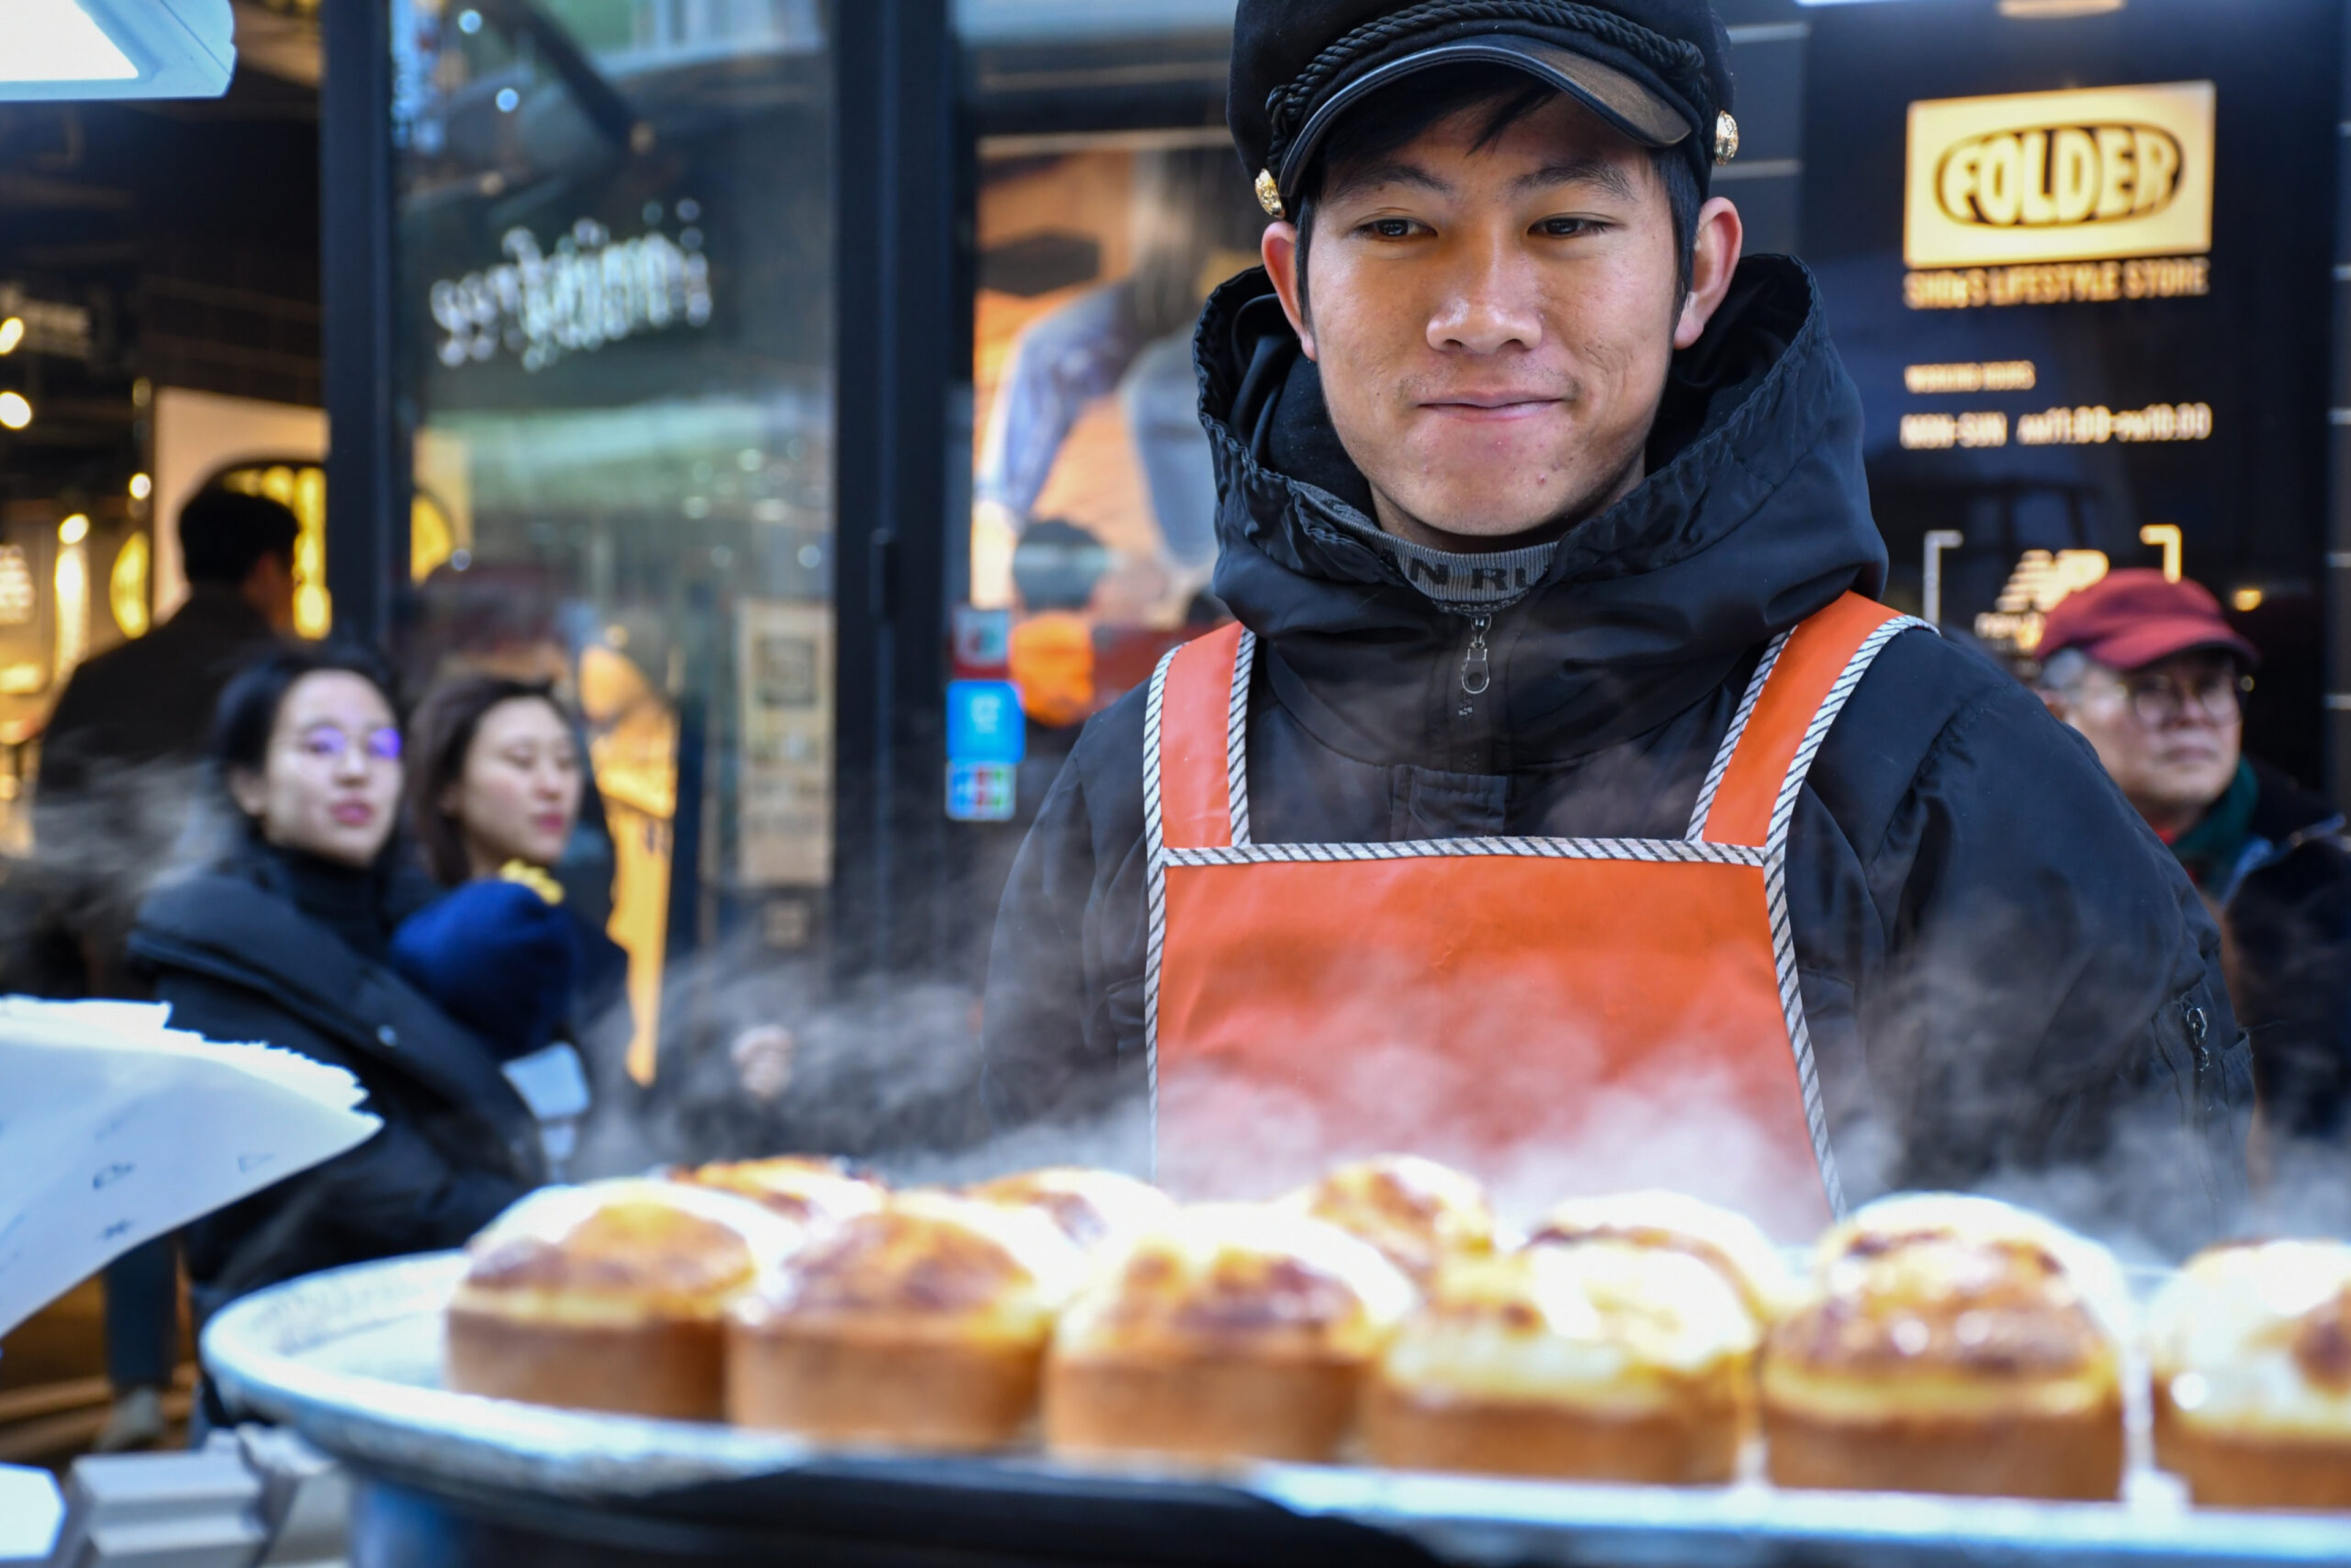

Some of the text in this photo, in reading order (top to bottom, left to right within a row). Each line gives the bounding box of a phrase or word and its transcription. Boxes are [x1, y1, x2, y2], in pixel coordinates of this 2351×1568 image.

[1942, 127, 2176, 227] FOLDER
[1988, 261, 2121, 307] LIFESTYLE
[2123, 256, 2210, 299] STORE
